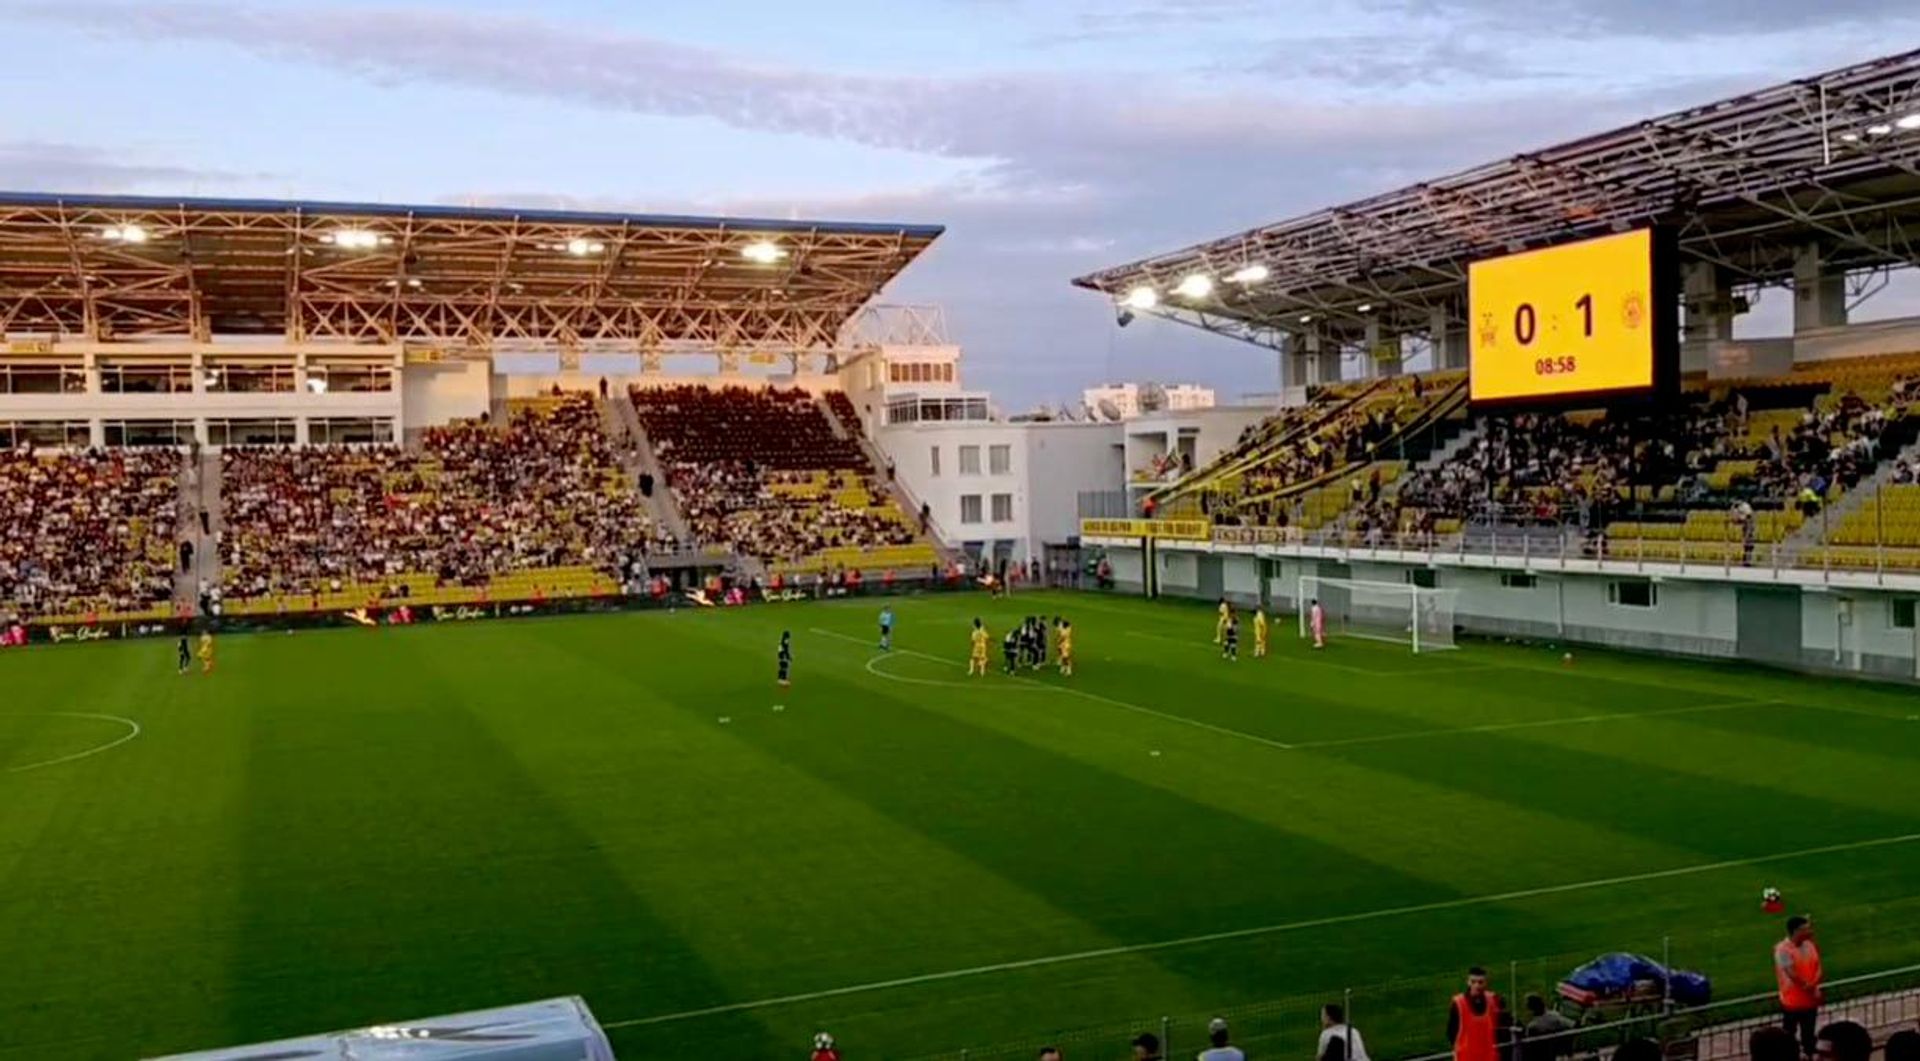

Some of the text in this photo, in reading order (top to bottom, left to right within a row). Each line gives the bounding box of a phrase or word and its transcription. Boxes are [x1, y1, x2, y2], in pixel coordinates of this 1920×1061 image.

[1514, 303, 1536, 345] 0
[1575, 293, 1593, 337] 1
[1535, 356, 1576, 375] 08:58
